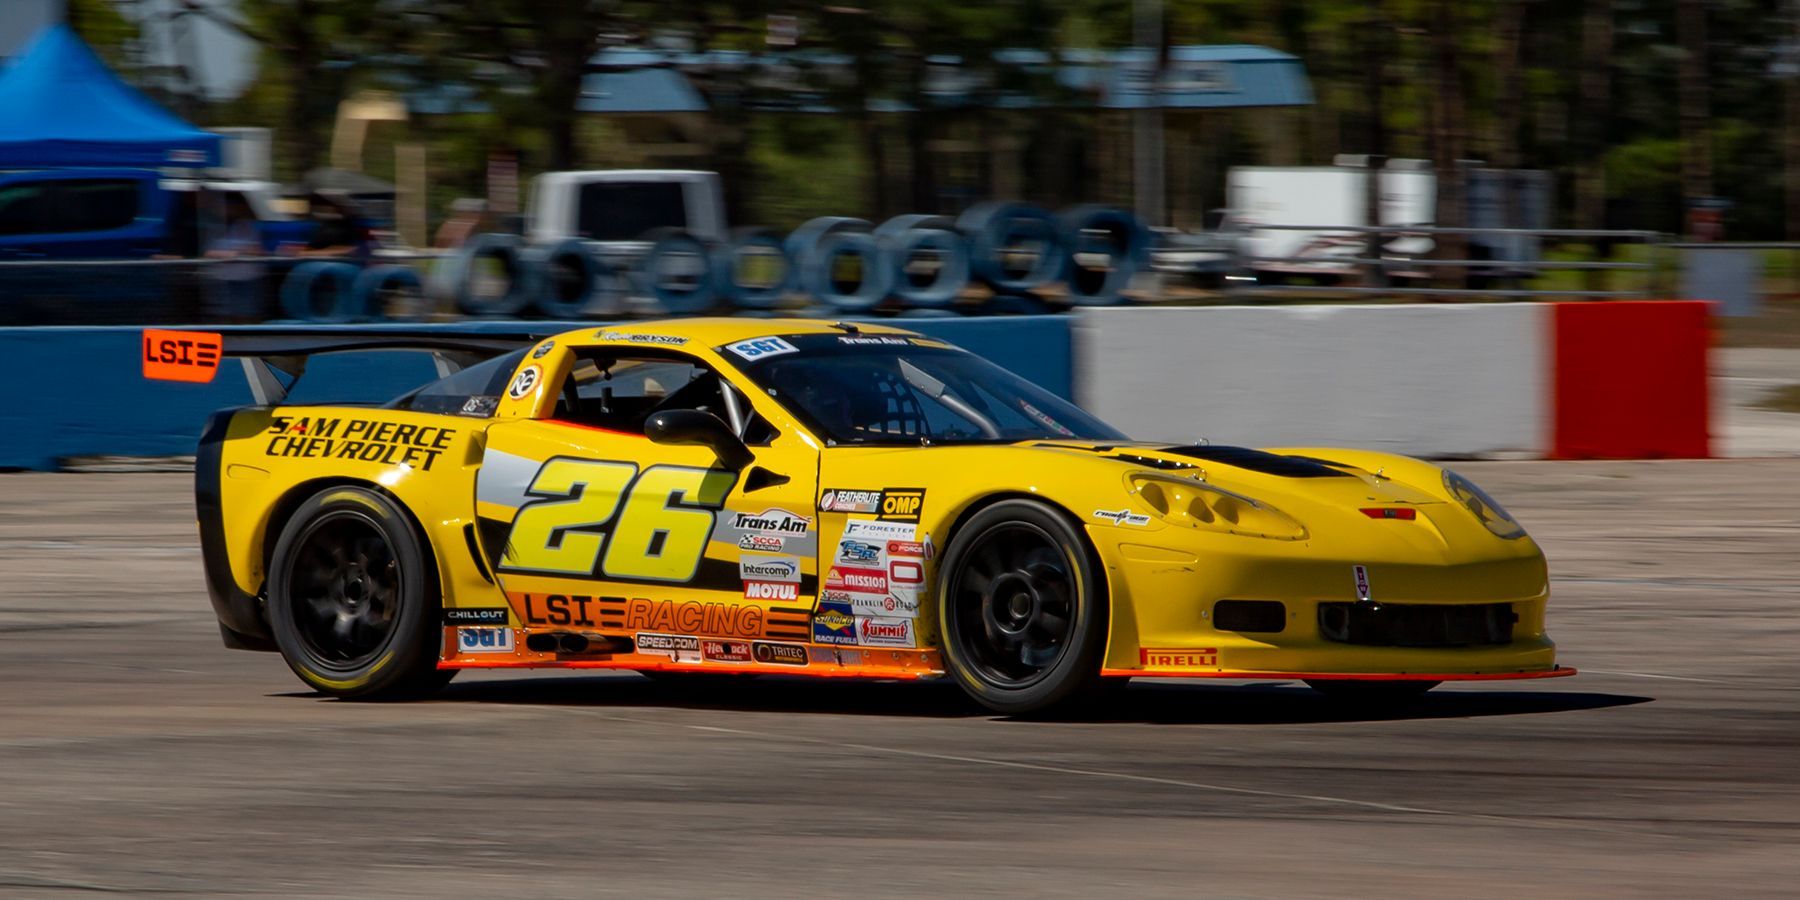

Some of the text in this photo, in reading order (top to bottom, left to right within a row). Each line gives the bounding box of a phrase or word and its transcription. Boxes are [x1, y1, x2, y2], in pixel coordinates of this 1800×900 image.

[736, 337, 789, 356] SGT
[838, 336, 908, 346] Trans Am
[268, 415, 457, 450] SAM PIERCE
[266, 437, 443, 472] CHEVROLET
[836, 490, 881, 504] FEATHERLITE
[883, 496, 920, 514] OMP
[496, 455, 740, 583] 26
[735, 512, 807, 533] Trans Am
[863, 525, 915, 535] FORESTER
[753, 536, 782, 546] SCCA
[743, 563, 789, 579] Intercomp
[845, 574, 886, 588] mission
[746, 583, 798, 600] MOTUL
[853, 599, 883, 607] FRANKLIN
[448, 611, 503, 620] CHILLOUT
[626, 598, 764, 637] RACING
[815, 615, 854, 625] SUNOCO
[815, 634, 858, 644] RACE FUELS
[772, 645, 804, 658] TRITEC
[1139, 647, 1218, 667] PIRELLI
